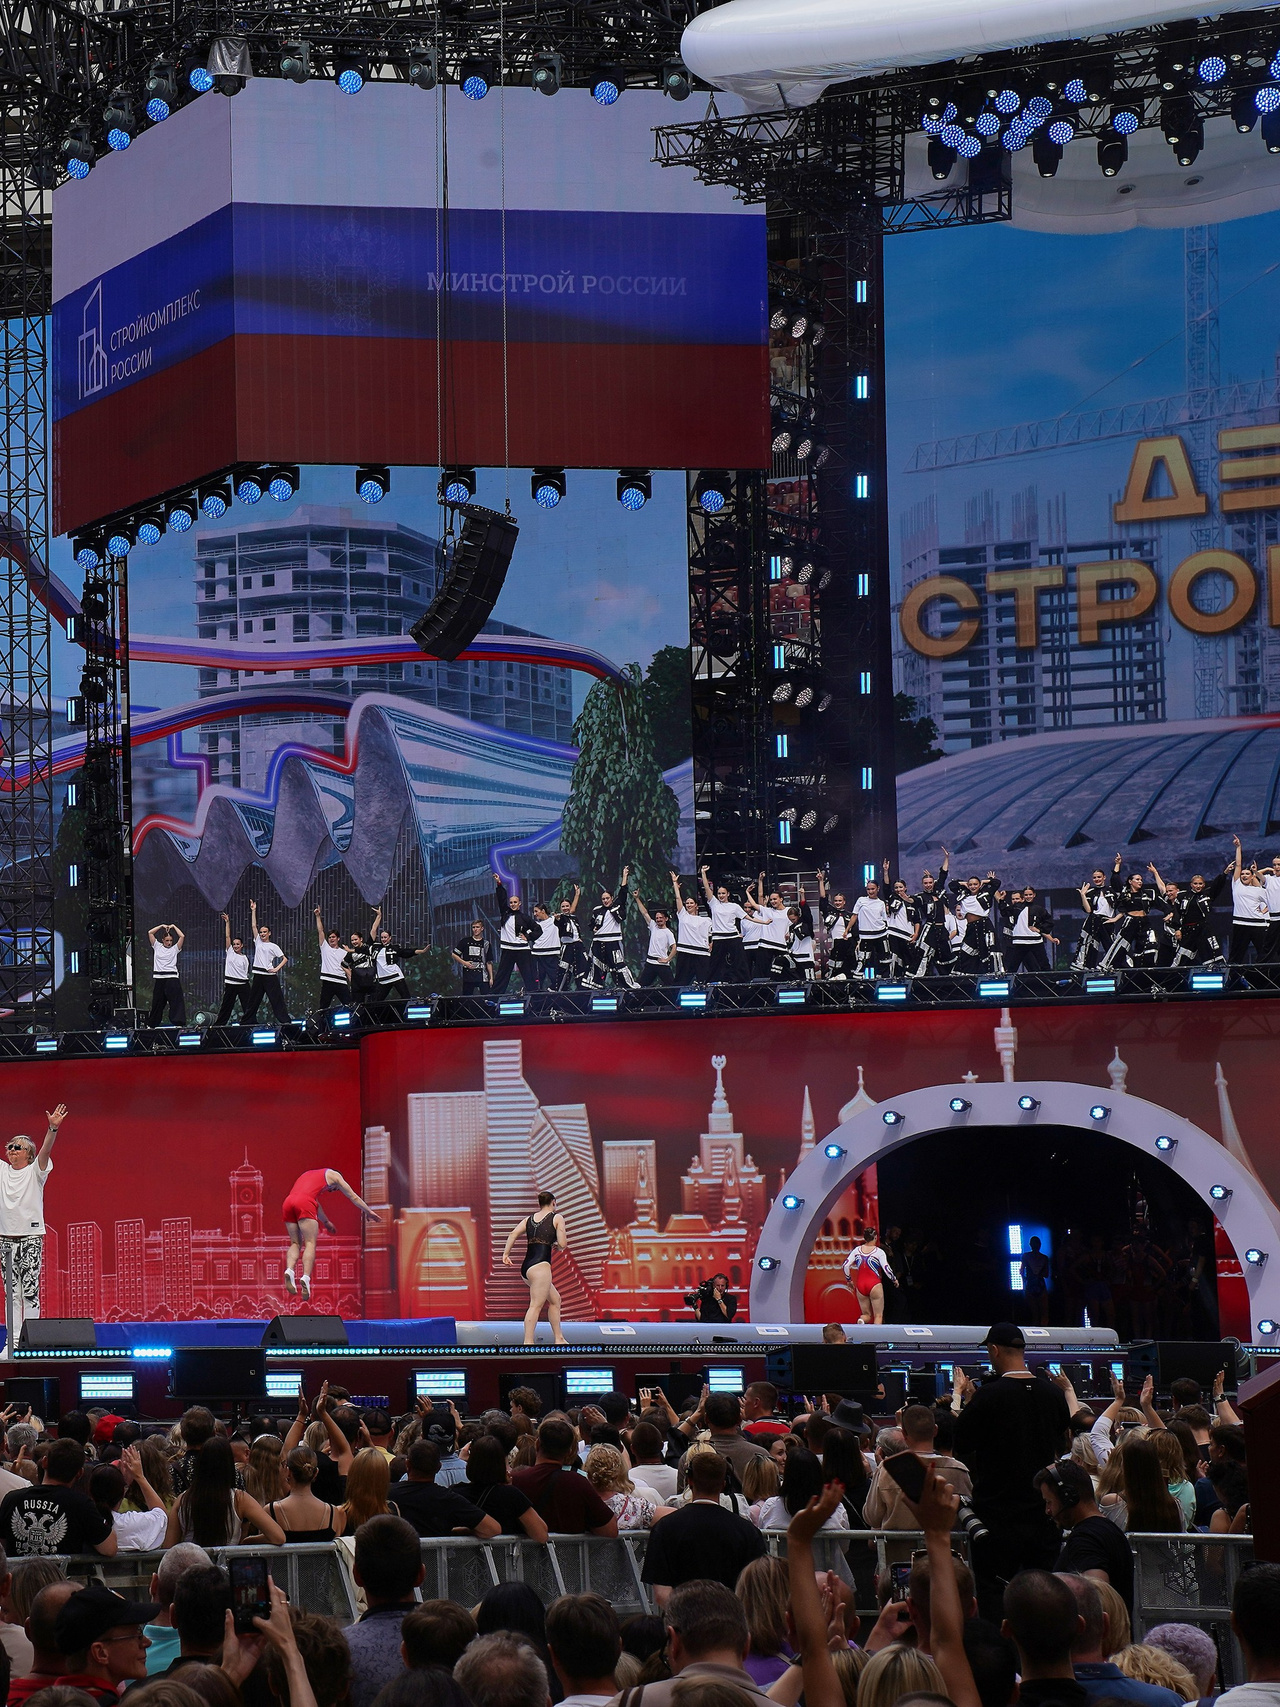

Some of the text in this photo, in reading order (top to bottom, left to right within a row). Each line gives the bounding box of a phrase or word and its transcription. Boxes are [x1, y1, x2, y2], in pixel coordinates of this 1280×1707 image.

[427, 269, 688, 296] МИНСТРОЙ РОССИИ
[110, 289, 201, 352] СТРОЙКОМПЛЕКС
[111, 346, 152, 384] РОССИИ
[899, 545, 1280, 658] СТРО
[23, 1499, 60, 1514] RUSSIA
